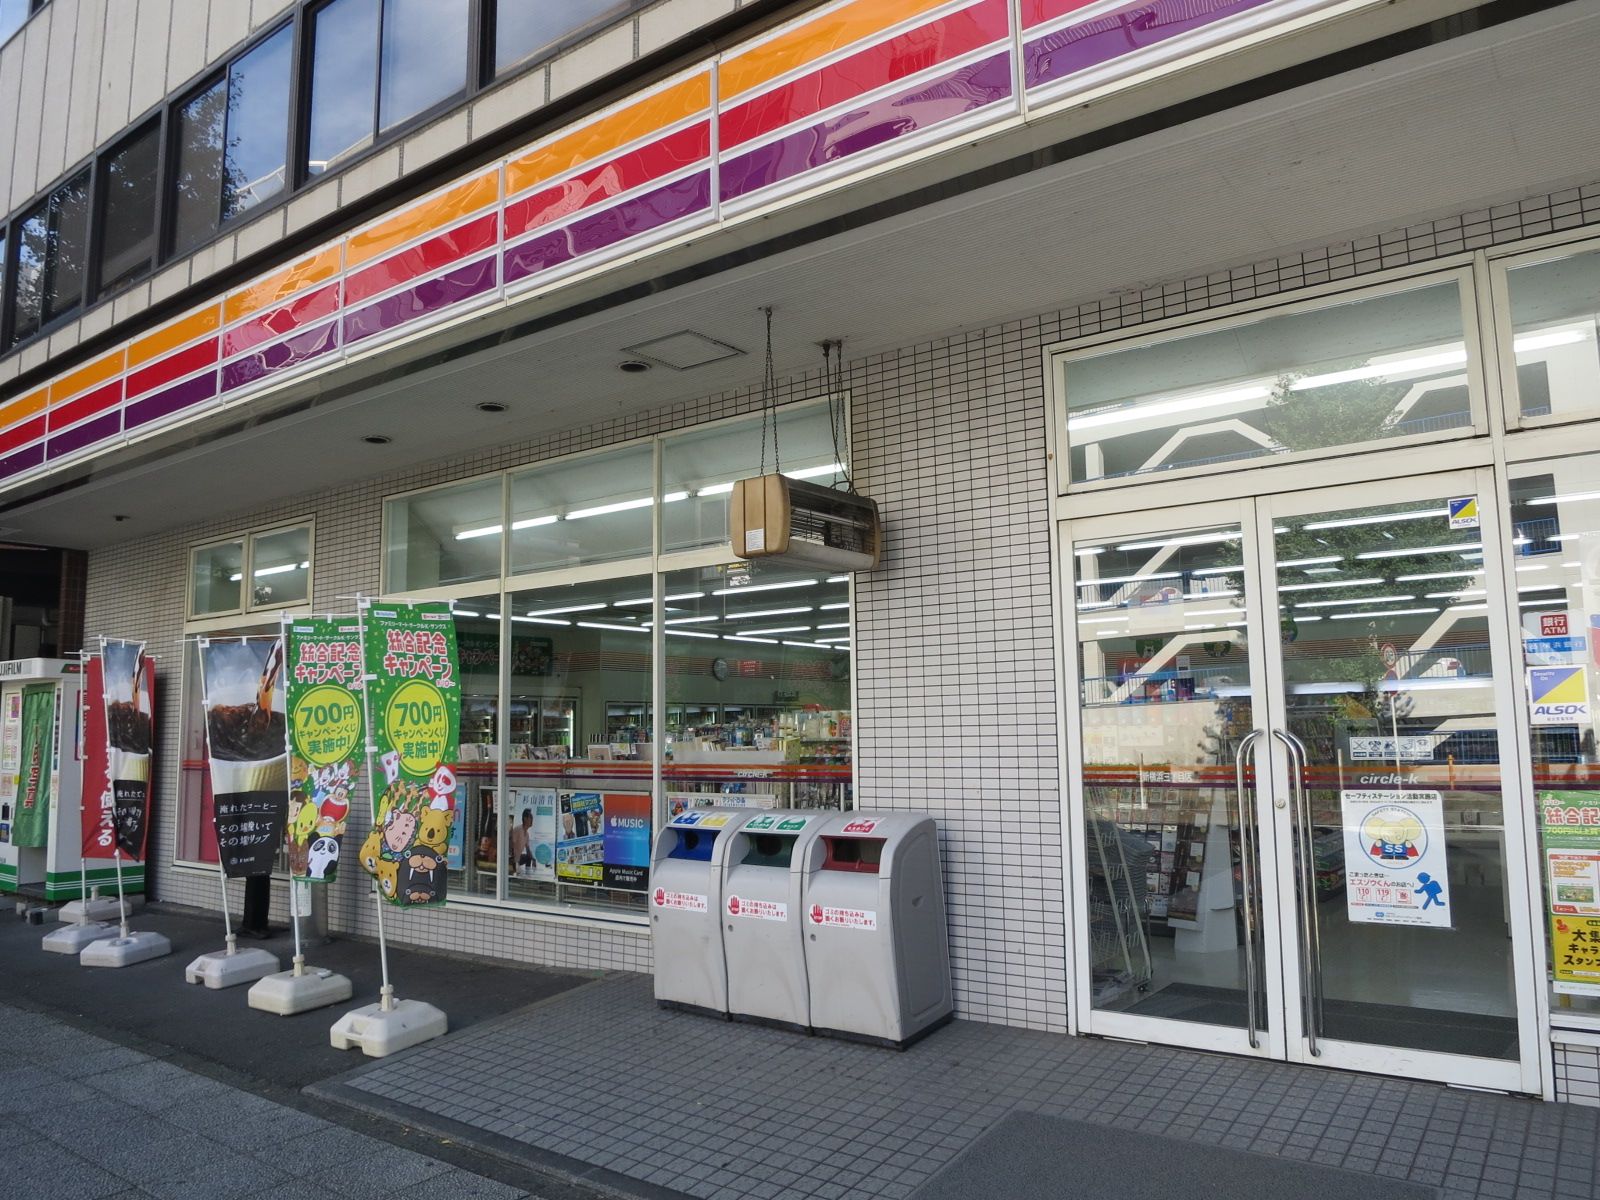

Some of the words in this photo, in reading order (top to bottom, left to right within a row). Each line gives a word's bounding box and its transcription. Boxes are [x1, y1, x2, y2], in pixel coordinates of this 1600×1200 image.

[1543, 617, 1565, 626] 銀行
[1543, 625, 1567, 635] ATM
[386, 629, 448, 656] 統合記念
[300, 642, 361, 663] 統合記念
[383, 652, 452, 680] キャンペーン
[294, 663, 364, 685] キャンペーン
[300, 702, 354, 728] 700円
[394, 701, 442, 727] 700円
[1534, 705, 1587, 715] ALSOK
[298, 723, 357, 738] キャンペーンくじ
[393, 727, 445, 740] キャンペーンくじ
[1360, 773, 1419, 785] circle-k
[617, 818, 644, 829] MUSIC
[1385, 844, 1403, 853] SS
[1358, 888, 1370, 896] 110
[1377, 889, 1390, 897] 119
[825, 908, 865, 918] ゴミの持ち込みは
